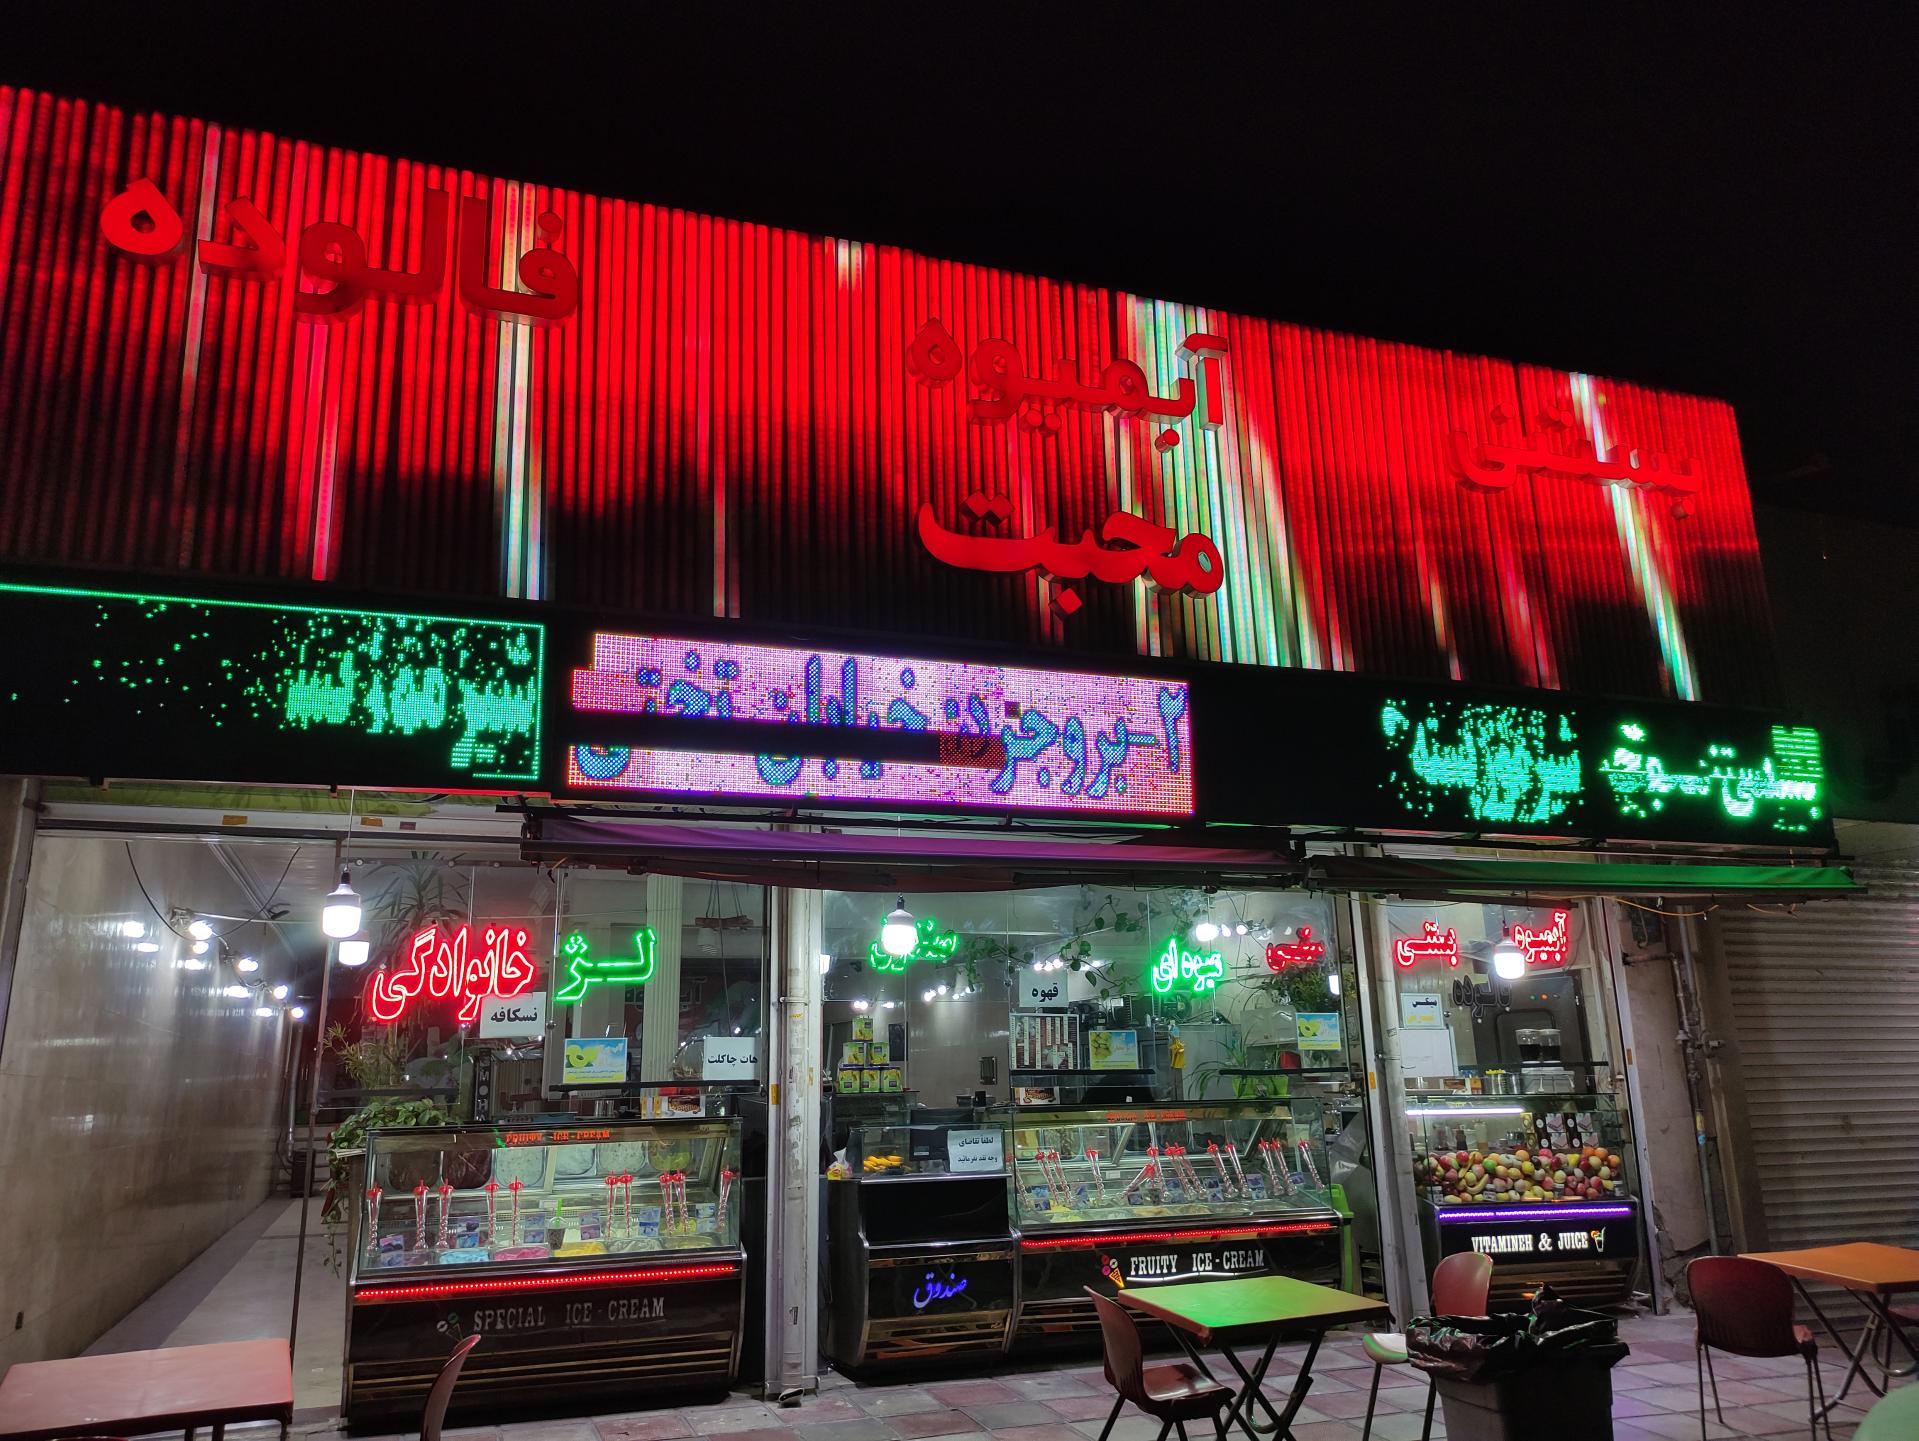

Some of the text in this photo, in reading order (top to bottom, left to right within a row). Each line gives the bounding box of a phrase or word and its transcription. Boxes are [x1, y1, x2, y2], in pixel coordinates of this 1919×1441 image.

[101, 178, 578, 326] فالوده
[906, 317, 1228, 453] آبمیوه
[1451, 402, 1702, 520] بستنی
[917, 490, 1224, 620] محبت
[1396, 921, 1458, 966] بستنی
[1514, 911, 1567, 962] آبمیوه
[372, 923, 535, 1022] خانوادگی
[1031, 982, 1059, 1003] قهوه
[490, 1005, 538, 1023] نسکافه
[707, 1053, 758, 1068] هات چاکلت
[1471, 1231, 1589, 1253] VITAMINEH & JUICE
[1130, 1255, 1178, 1276] FRUITY
[913, 1271, 967, 1309] صندوق
[473, 1306, 546, 1332] SPECIAL
